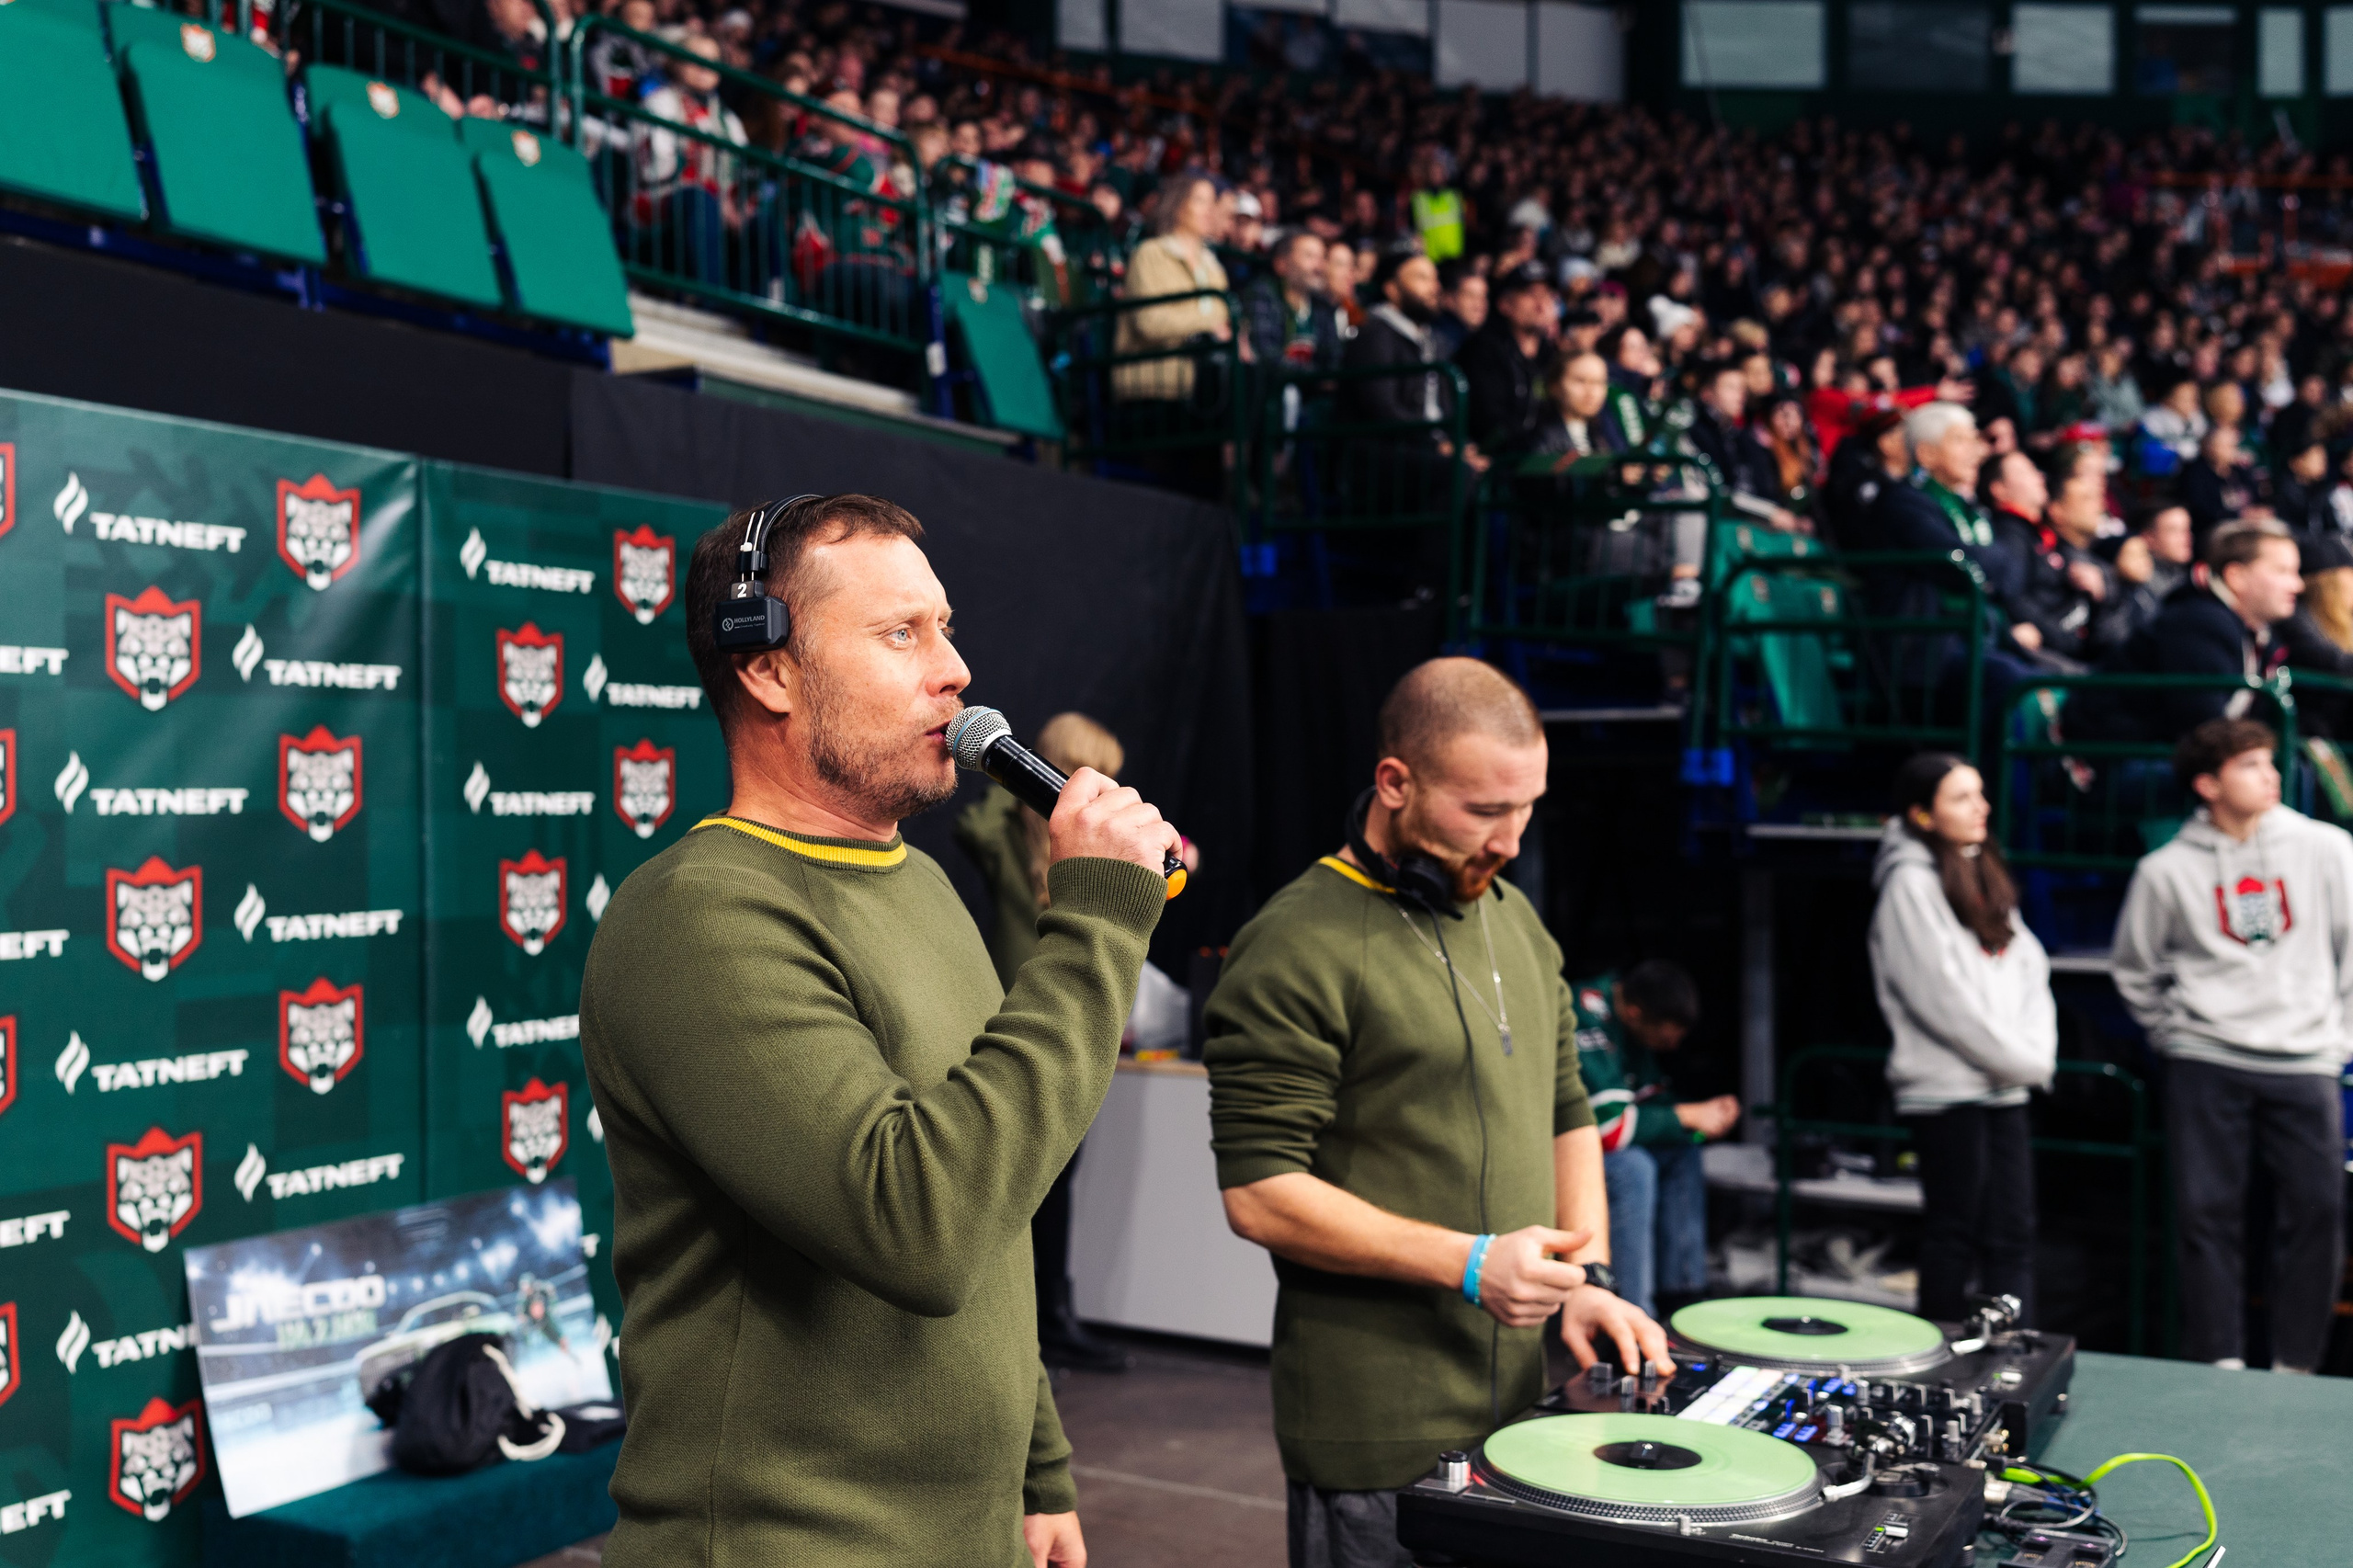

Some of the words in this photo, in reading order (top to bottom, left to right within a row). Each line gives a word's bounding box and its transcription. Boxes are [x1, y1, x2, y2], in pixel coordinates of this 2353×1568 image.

[91, 512, 246, 553] TATNEFT
[485, 560, 595, 594] TATNEFT
[737, 583, 747, 598] 2
[733, 615, 765, 623] HOLLYLAND
[265, 659, 402, 690] TATNEFT
[608, 682, 702, 709] TATNEFT
[92, 788, 247, 816] TATNEFT
[489, 791, 595, 815] TATNEFT
[266, 909, 403, 942] TATNEFT
[92, 1049, 248, 1092] TATNEFT
[267, 1153, 404, 1199] TATNEFT
[0, 1489, 72, 1534] EFT
